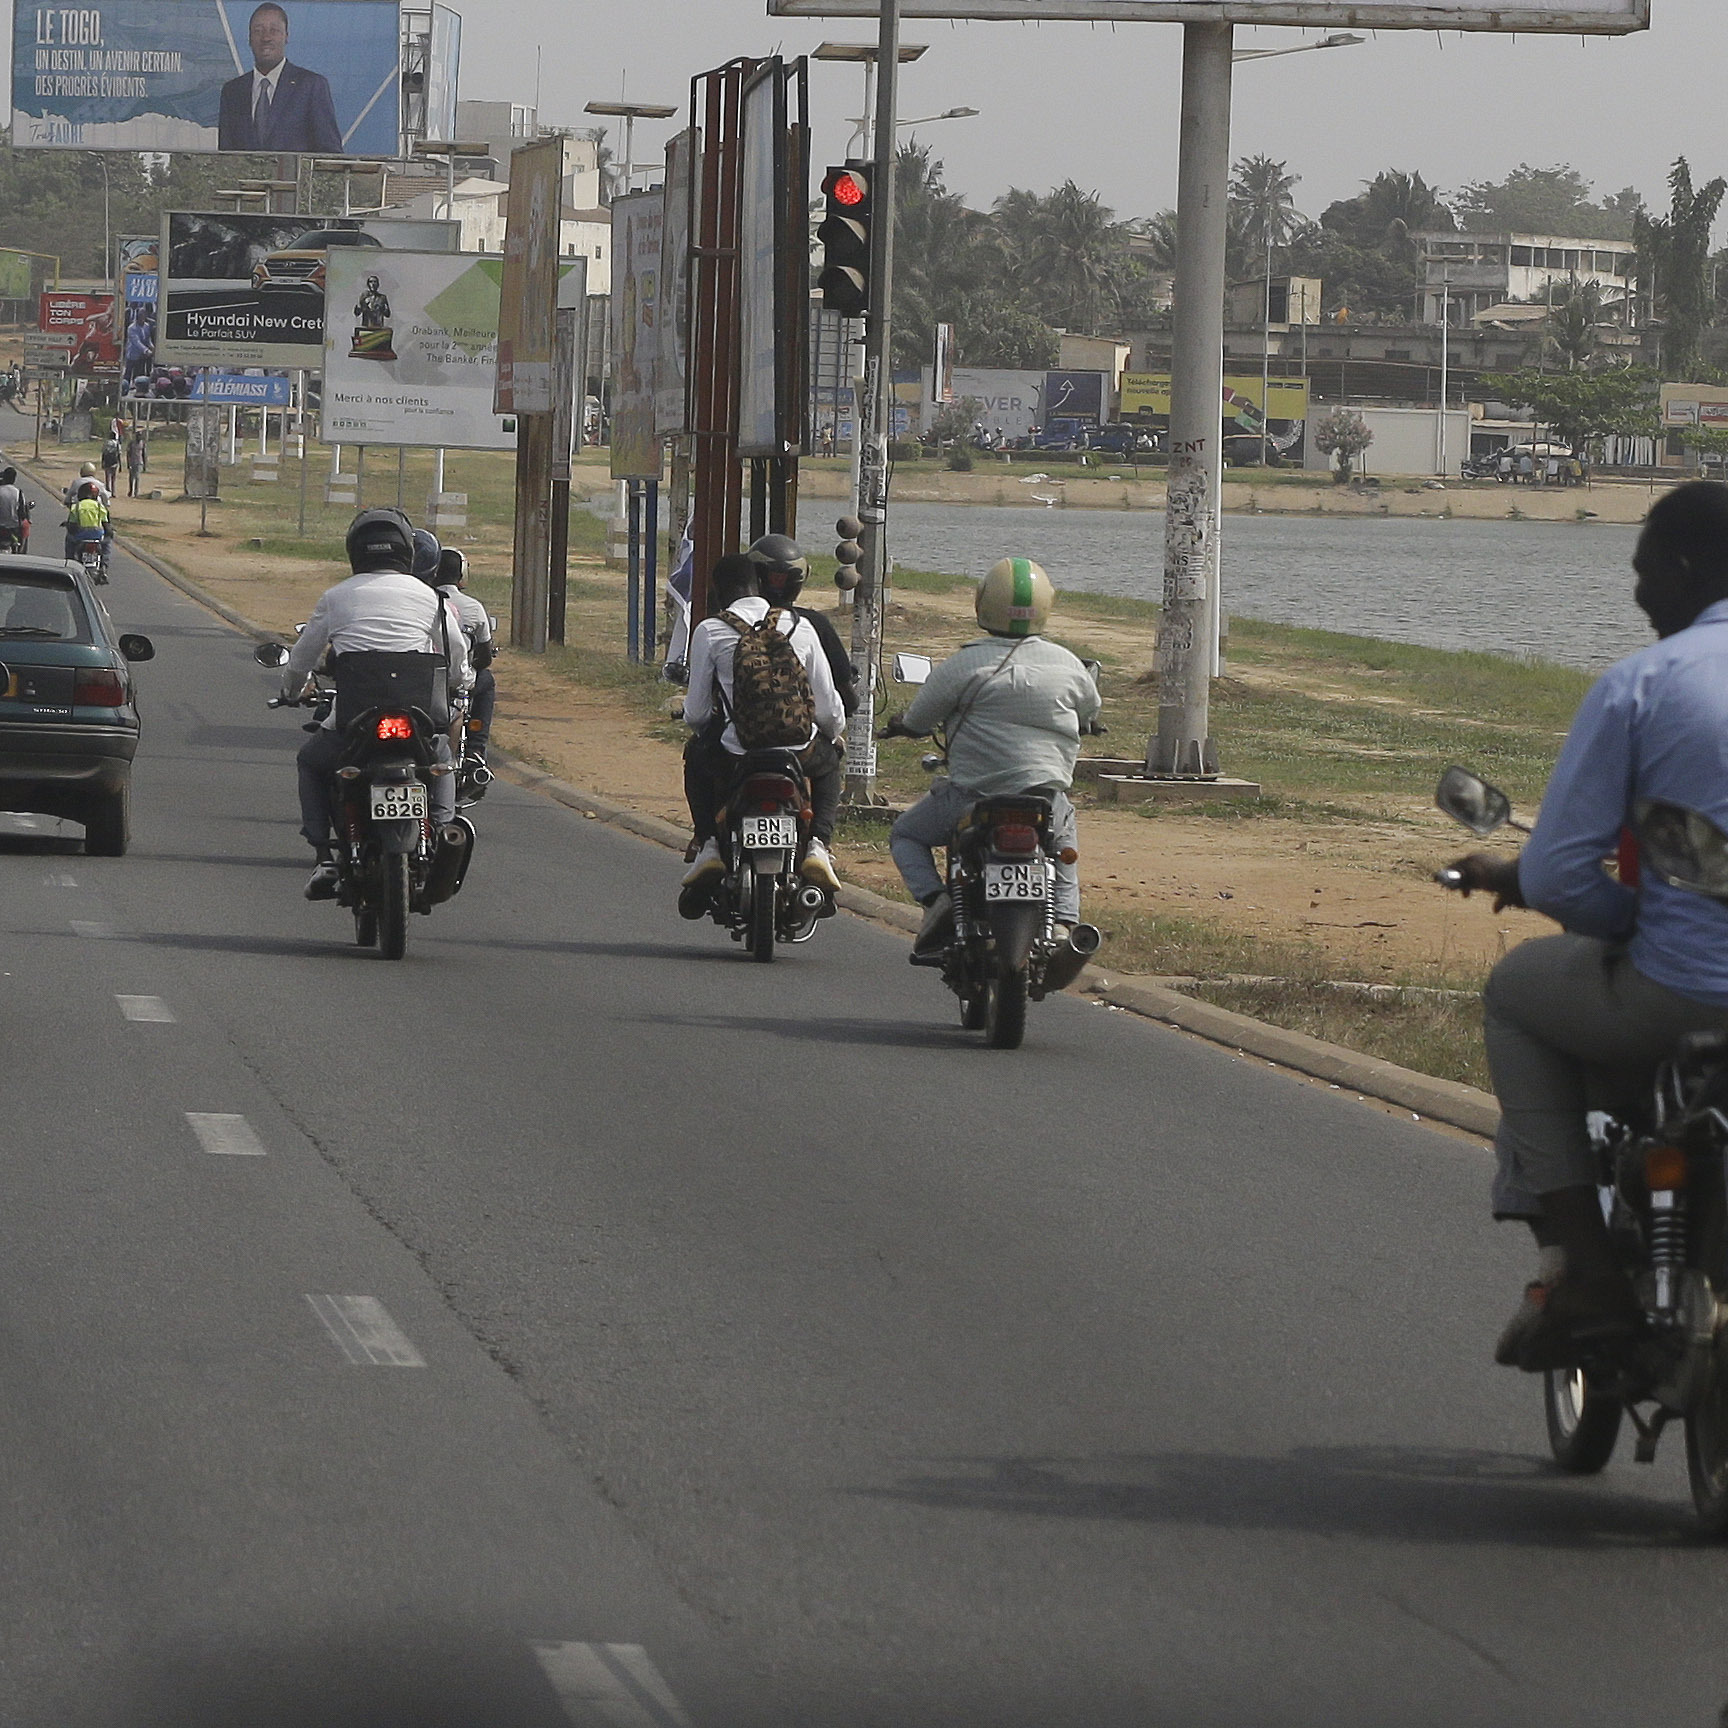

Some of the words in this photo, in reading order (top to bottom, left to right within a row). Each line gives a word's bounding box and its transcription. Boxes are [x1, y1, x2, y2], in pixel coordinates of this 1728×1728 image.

[36, 9, 55, 45] LE
[60, 9, 105, 48] TOGO,
[36, 49, 49, 70] UN
[51, 50, 87, 71] DESTIN.
[89, 51, 103, 71] UN
[105, 51, 141, 72] AVENIR
[142, 52, 184, 73] CERTAIN.
[36, 75, 53, 96] DES
[56, 72, 98, 97] PROGRÈS
[101, 72, 148, 97] ÉVIDENTS.
[131, 286, 158, 298] FAU
[49, 309, 72, 317] TON
[187, 313, 249, 328] Hyundai
[254, 315, 287, 328] New
[187, 328, 198, 337] Le
[202, 328, 233, 338] Parfait
[235, 330, 256, 339] SUV
[412, 326, 451, 338] Orabank,
[420, 342, 440, 352] pour
[441, 341, 450, 350] la
[426, 353, 444, 363] The
[445, 354, 479, 365] Banker,
[481, 355, 497, 366] Fin
[335, 393, 363, 403] Merci
[366, 394, 372, 404] à
[375, 397, 393, 405] nos
[396, 396, 429, 407] clients
[1173, 438, 1206, 454] ZNT
[385, 788, 408, 801] CJ
[374, 803, 423, 817] 6826
[758, 819, 780, 832] BN
[746, 833, 793, 846] 8661
[1001, 866, 1028, 880] CN
[988, 883, 1043, 897] 3785
